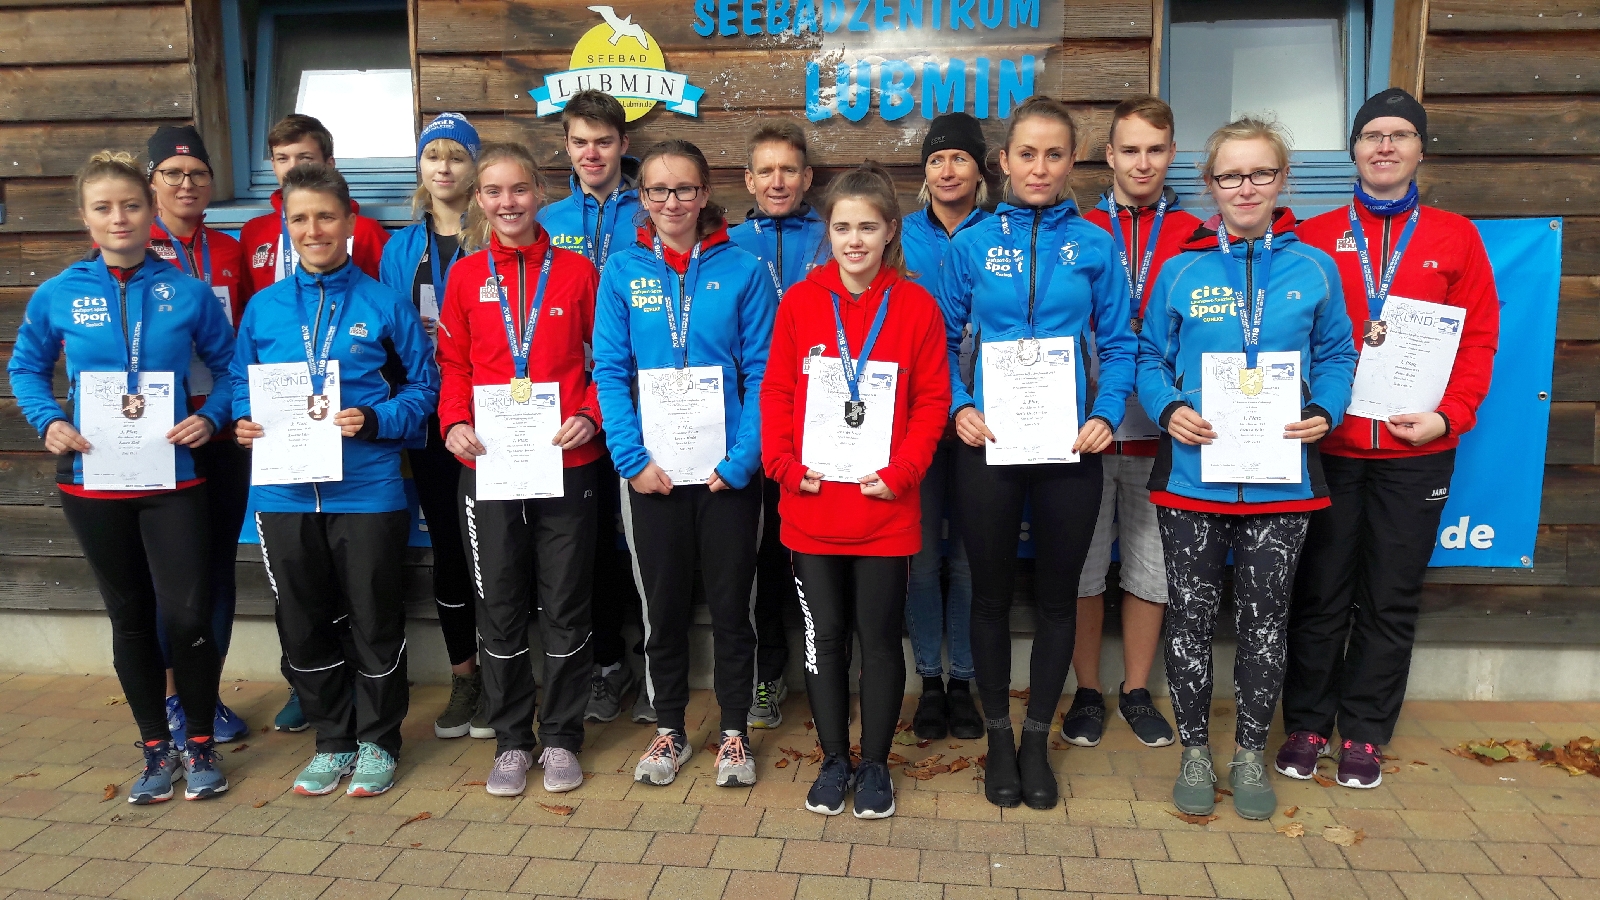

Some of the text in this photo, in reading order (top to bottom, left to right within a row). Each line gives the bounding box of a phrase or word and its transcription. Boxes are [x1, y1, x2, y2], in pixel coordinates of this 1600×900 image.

[693, 0, 1040, 37] SEEBADZENTRUM
[587, 54, 647, 63] SEEBAD
[557, 73, 677, 98] LUBMIN
[805, 55, 1035, 122] LUBMIN
[552, 233, 584, 245] city
[1264, 234, 1272, 250] 2018
[1360, 250, 1368, 264] 2018
[985, 262, 1023, 272] Spot
[1191, 285, 1233, 300] city
[1235, 291, 1245, 307] 2018
[1378, 283, 1389, 300] 2018
[631, 295, 664, 308] Spor
[503, 307, 511, 322] 2018
[1189, 301, 1237, 319] Sport
[301, 325, 310, 341] 2018
[671, 332, 679, 348] 2018
[1251, 328, 1260, 345] 2018
[521, 343, 529, 358] 2018
[131, 356, 139, 373] 2018
[318, 360, 326, 376] 2018
[1440, 515, 1495, 549] de
[465, 495, 485, 600] LAUFGRUPPE
